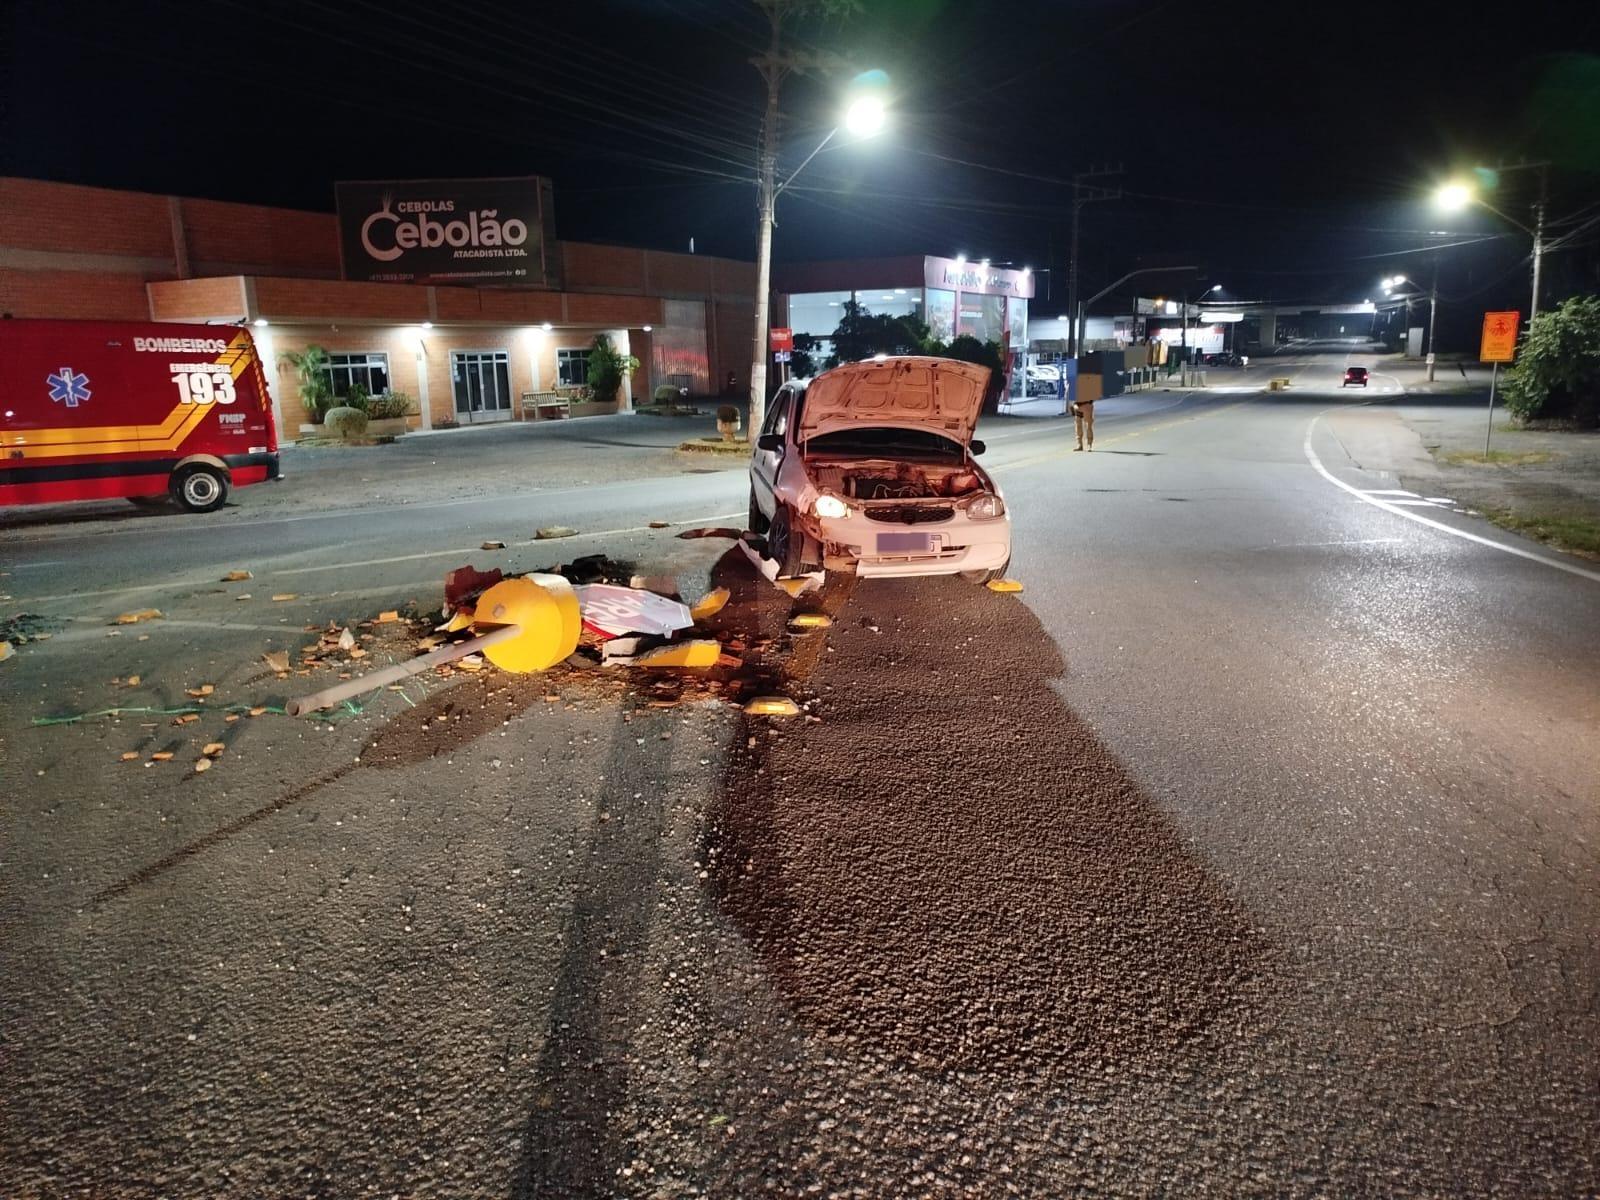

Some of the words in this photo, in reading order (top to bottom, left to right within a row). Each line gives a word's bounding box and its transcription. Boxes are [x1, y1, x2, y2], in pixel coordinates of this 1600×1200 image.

[397, 200, 455, 213] CEBOLAS
[361, 209, 528, 261] Cebolão
[453, 249, 504, 259] ATACADISTA
[504, 248, 528, 257] LTDA.
[133, 337, 228, 354] BOMBEIROS
[171, 372, 237, 405] 193
